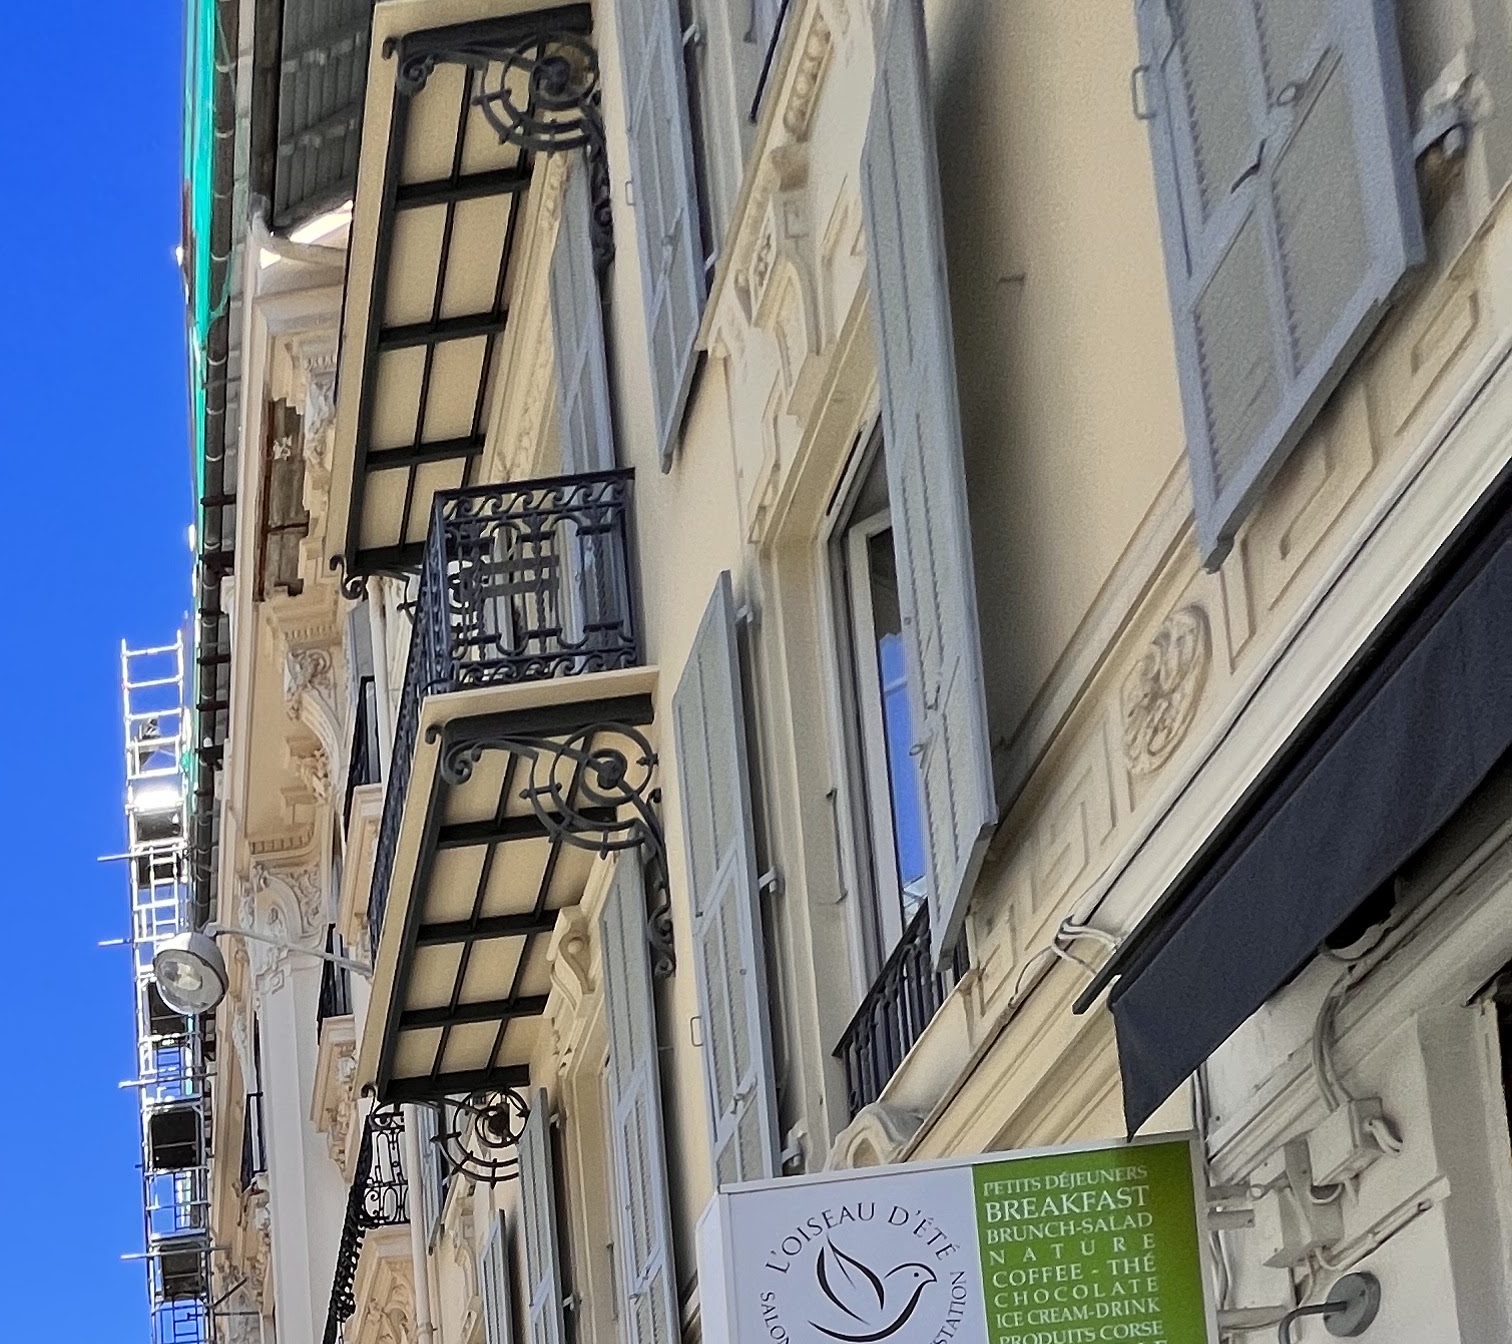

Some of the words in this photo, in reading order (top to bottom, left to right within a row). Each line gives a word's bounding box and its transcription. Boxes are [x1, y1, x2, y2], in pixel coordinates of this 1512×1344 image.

[983, 1177, 1040, 1196] PETITS
[1045, 1165, 1148, 1188] DÉJEUNERS
[985, 1185, 1150, 1223] BREAKFAST
[765, 1202, 875, 1274] L'OISEAU
[888, 1206, 960, 1261] D'ÉTÉ
[987, 1212, 1153, 1244] BRUNCH-SALAD
[992, 1263, 1083, 1288] COFFEE
[1106, 1251, 1156, 1275] THÉ
[994, 1277, 1159, 1308] CHOCOLATE
[996, 1312, 1024, 1328] ICE
[1027, 1298, 1160, 1325] CREAM-DRINK
[1100, 1320, 1164, 1340] CORSE
